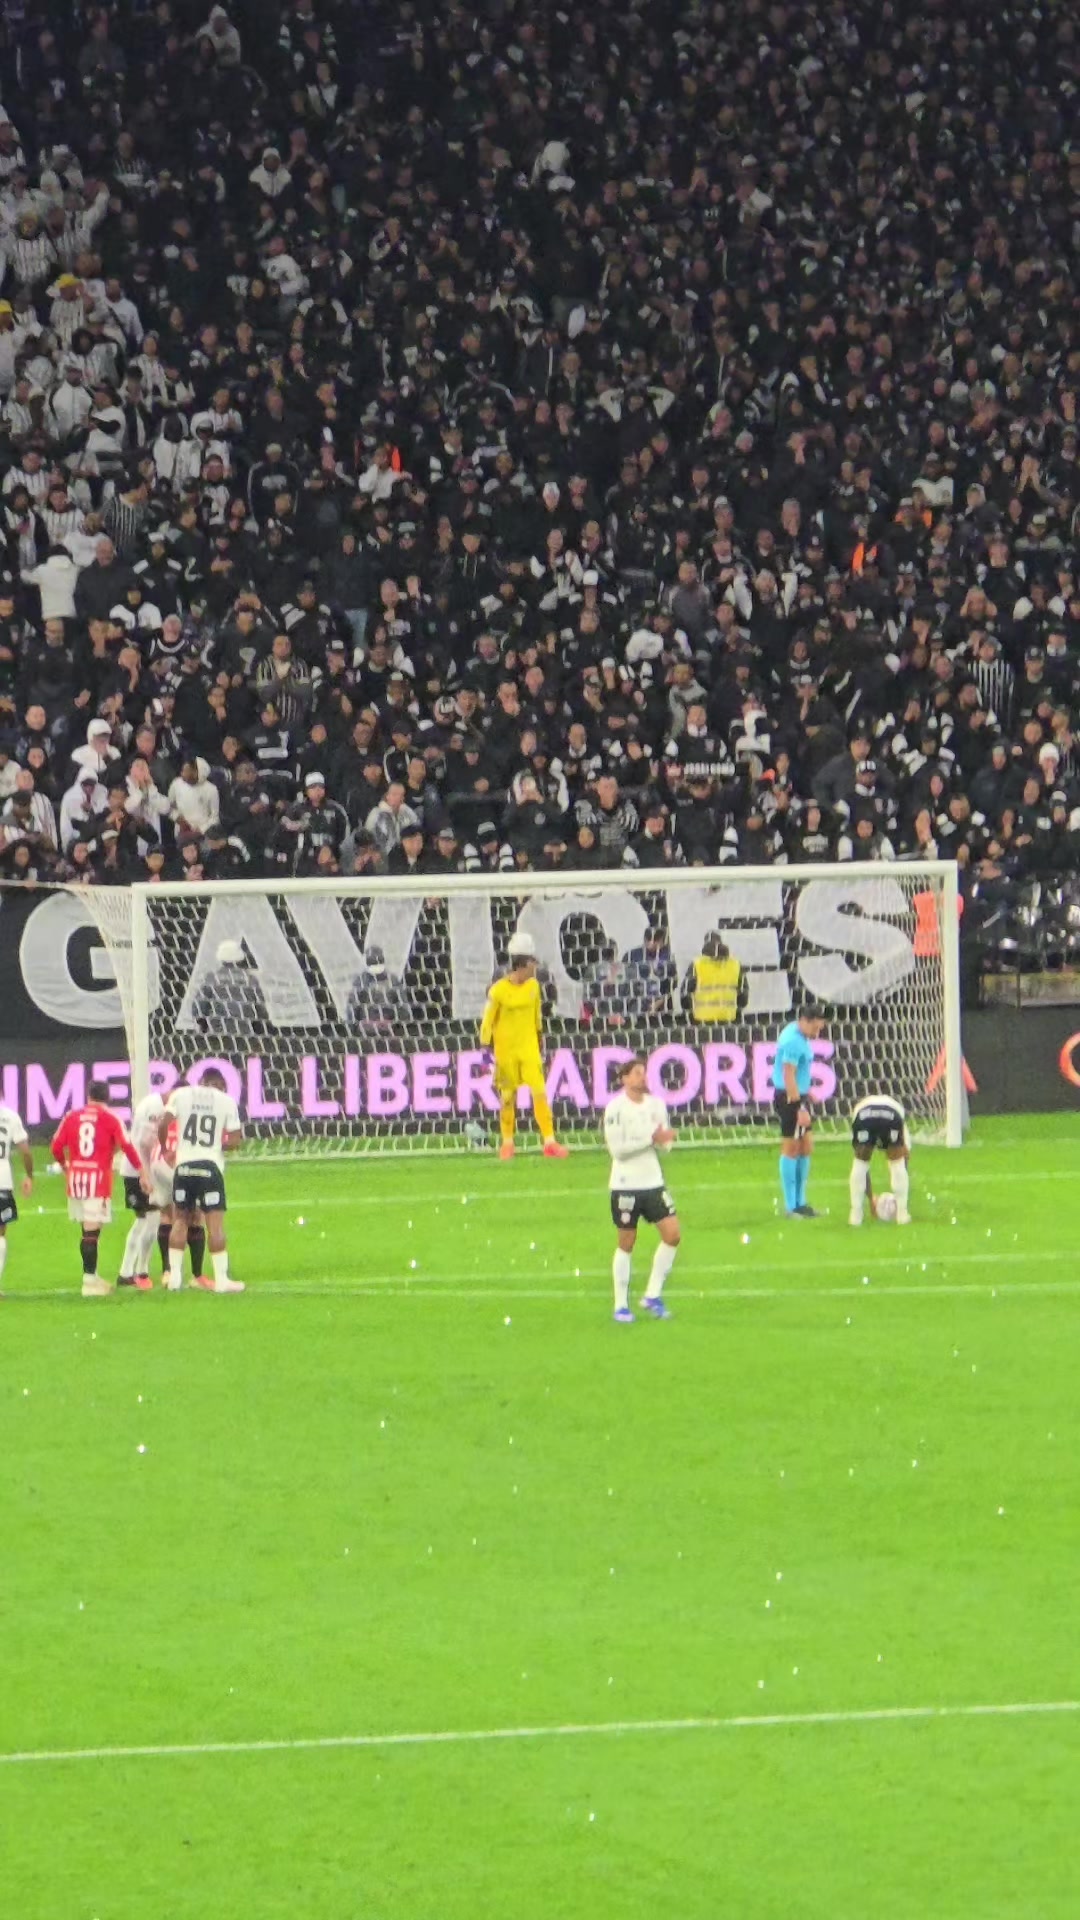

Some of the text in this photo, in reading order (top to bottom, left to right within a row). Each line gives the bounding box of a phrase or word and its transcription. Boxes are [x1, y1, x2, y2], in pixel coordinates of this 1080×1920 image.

[301, 1039, 837, 1116] LIBERADORES
[79, 1121, 96, 1159] 8
[182, 1113, 217, 1148] 49
